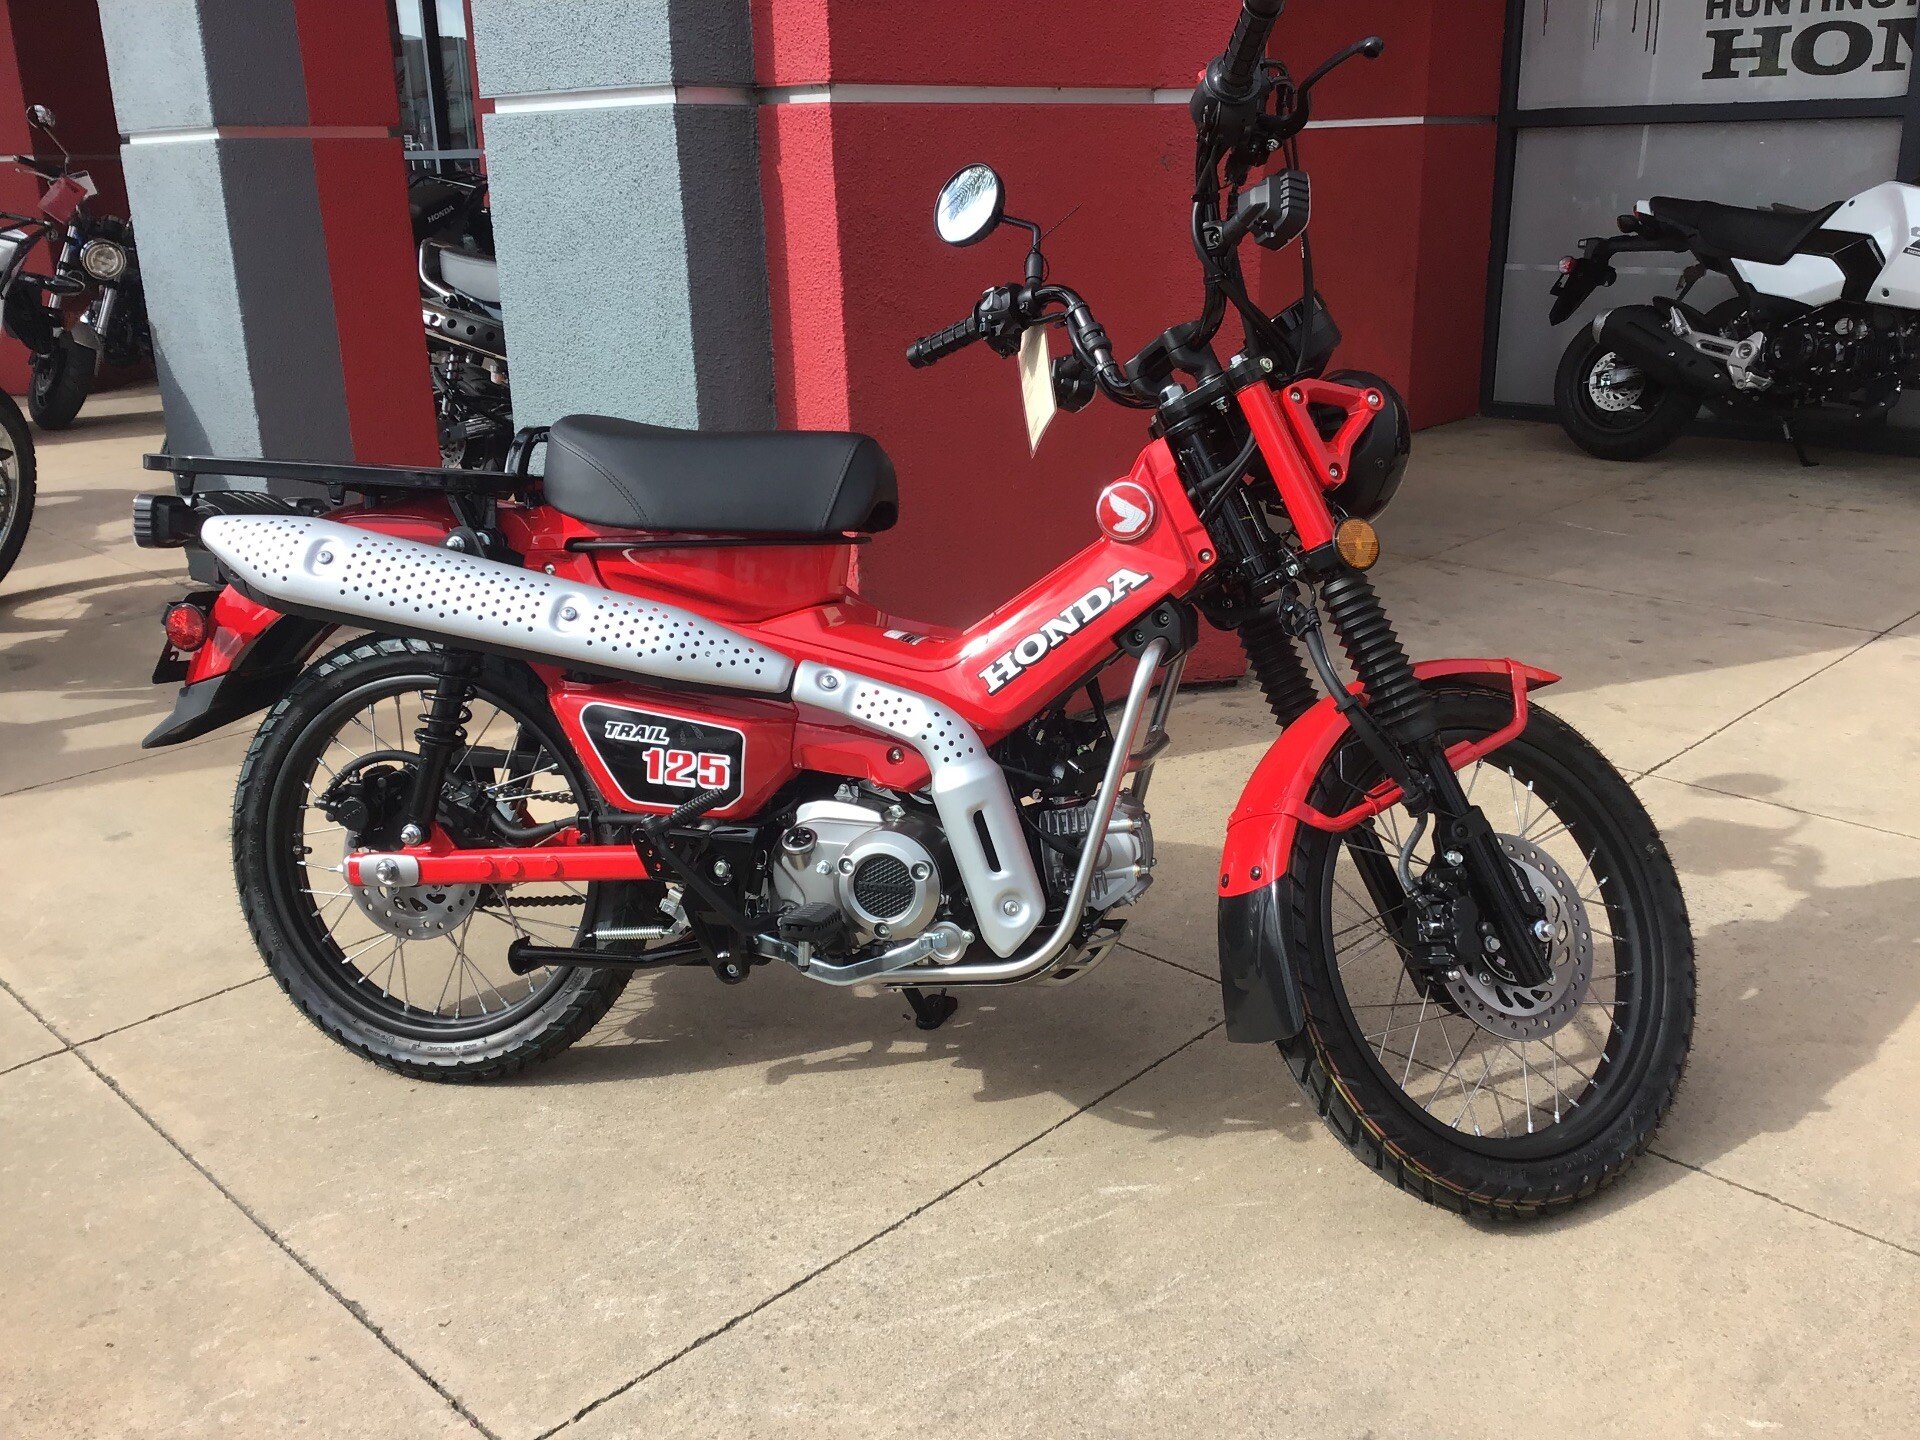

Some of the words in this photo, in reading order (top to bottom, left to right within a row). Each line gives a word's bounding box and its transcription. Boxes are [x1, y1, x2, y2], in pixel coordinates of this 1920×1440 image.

[427, 205, 455, 223] HONDA
[979, 568, 1150, 695] HONDA
[605, 720, 670, 745] TRAIL
[642, 747, 730, 790] 125
